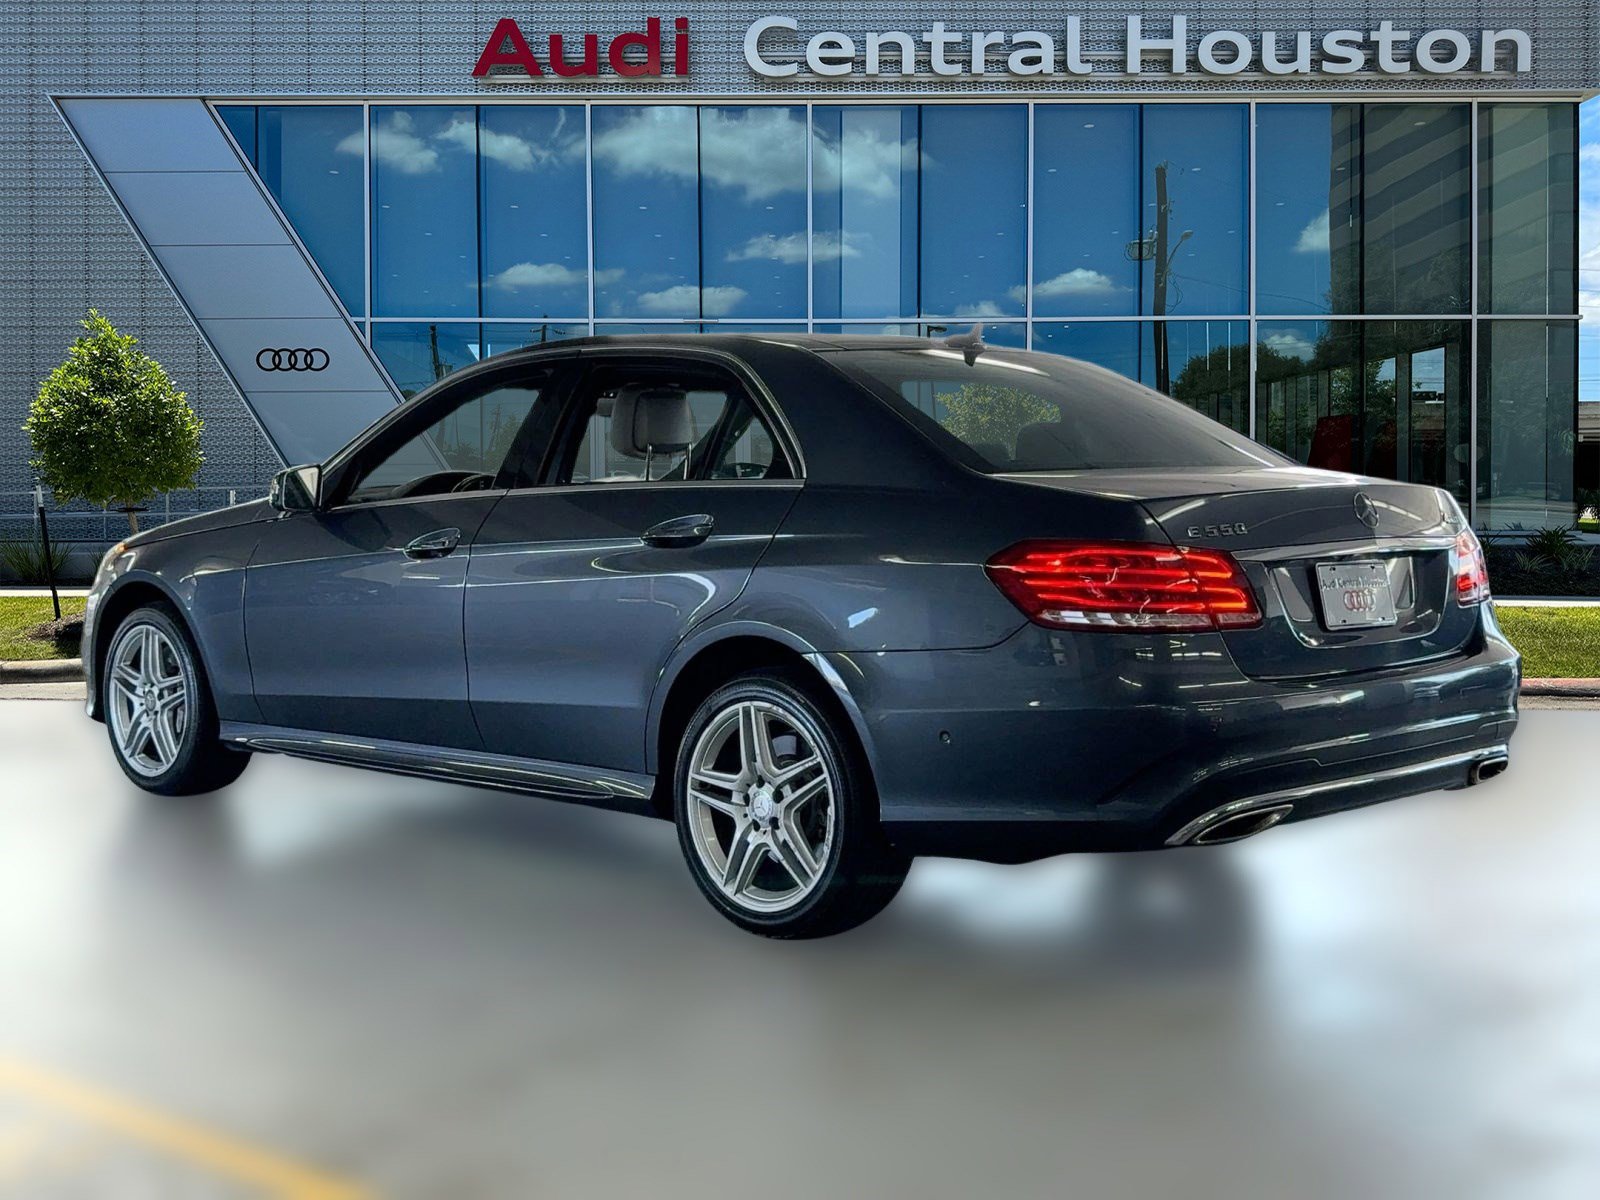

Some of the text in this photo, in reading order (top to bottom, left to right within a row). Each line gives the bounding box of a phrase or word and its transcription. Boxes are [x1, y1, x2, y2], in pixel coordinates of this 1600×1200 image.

[471, 14, 1532, 78] Audi Central Houston
[1187, 522, 1248, 538] E 550
